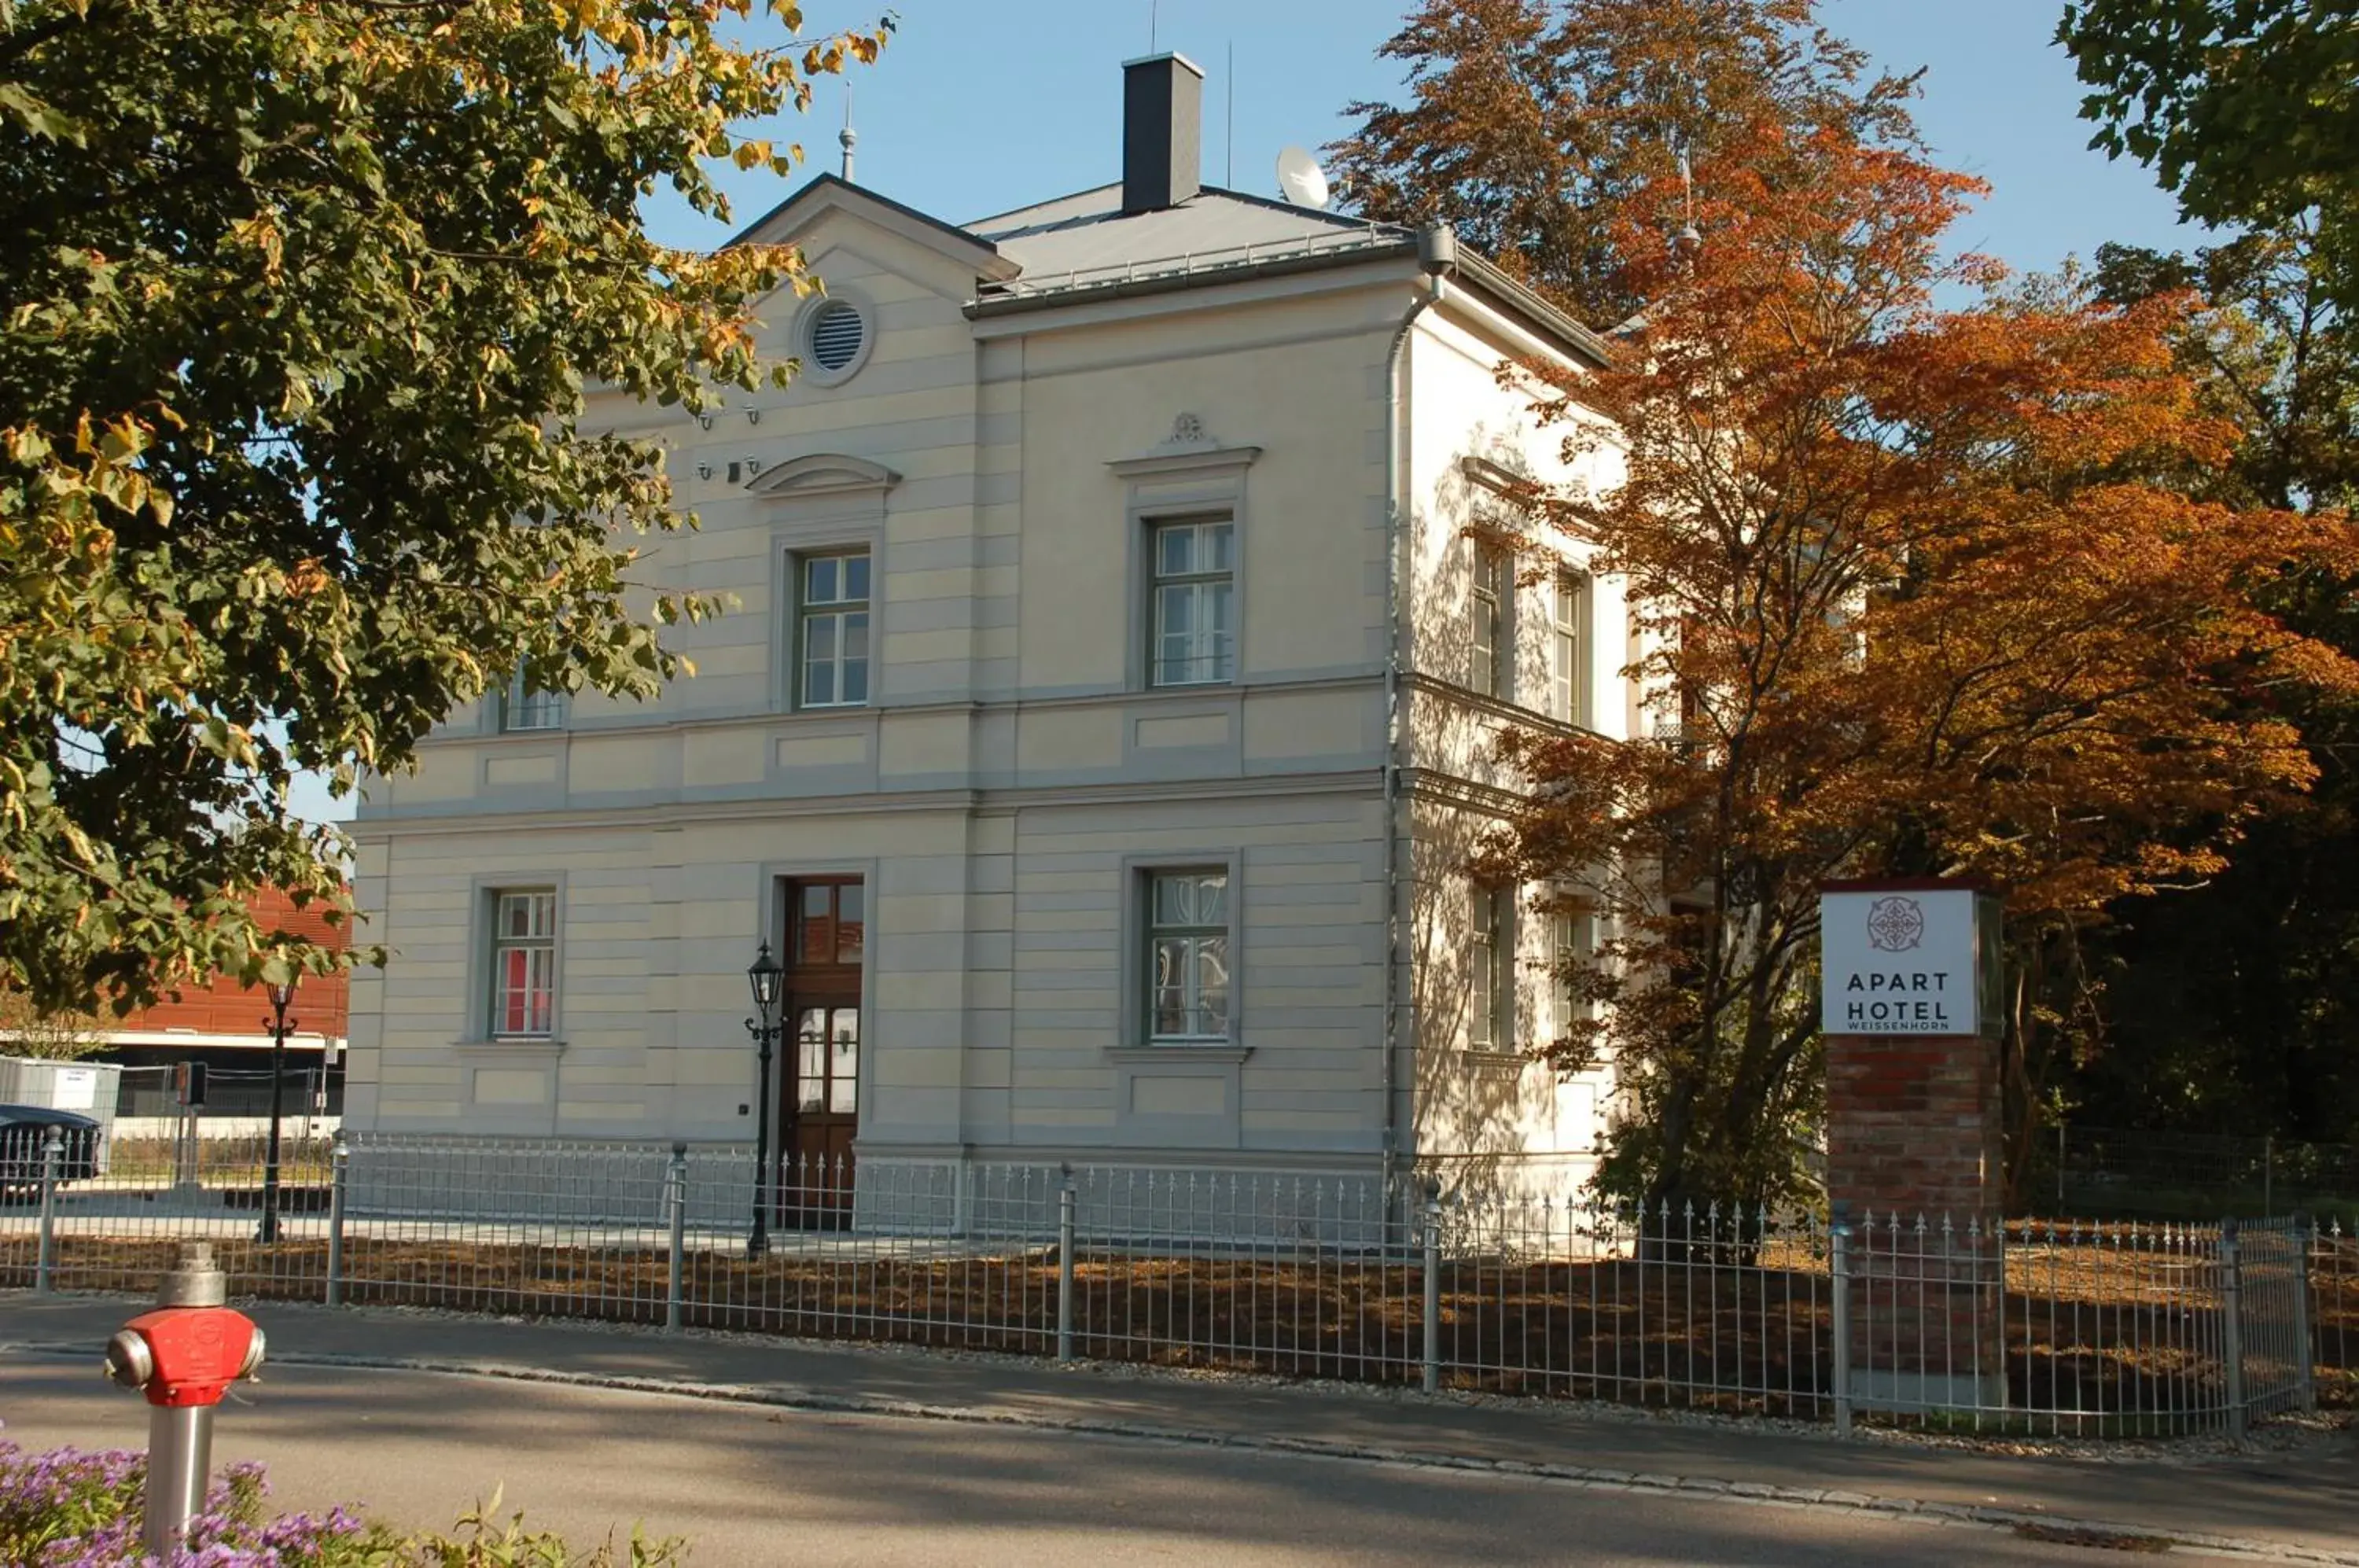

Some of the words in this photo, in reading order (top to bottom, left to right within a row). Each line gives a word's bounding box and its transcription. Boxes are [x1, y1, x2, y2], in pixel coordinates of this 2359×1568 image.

[1847, 973, 1949, 992] APART
[1848, 1002, 1948, 1020] HOTEL
[1848, 1021, 1949, 1030] WEISSENHORN
